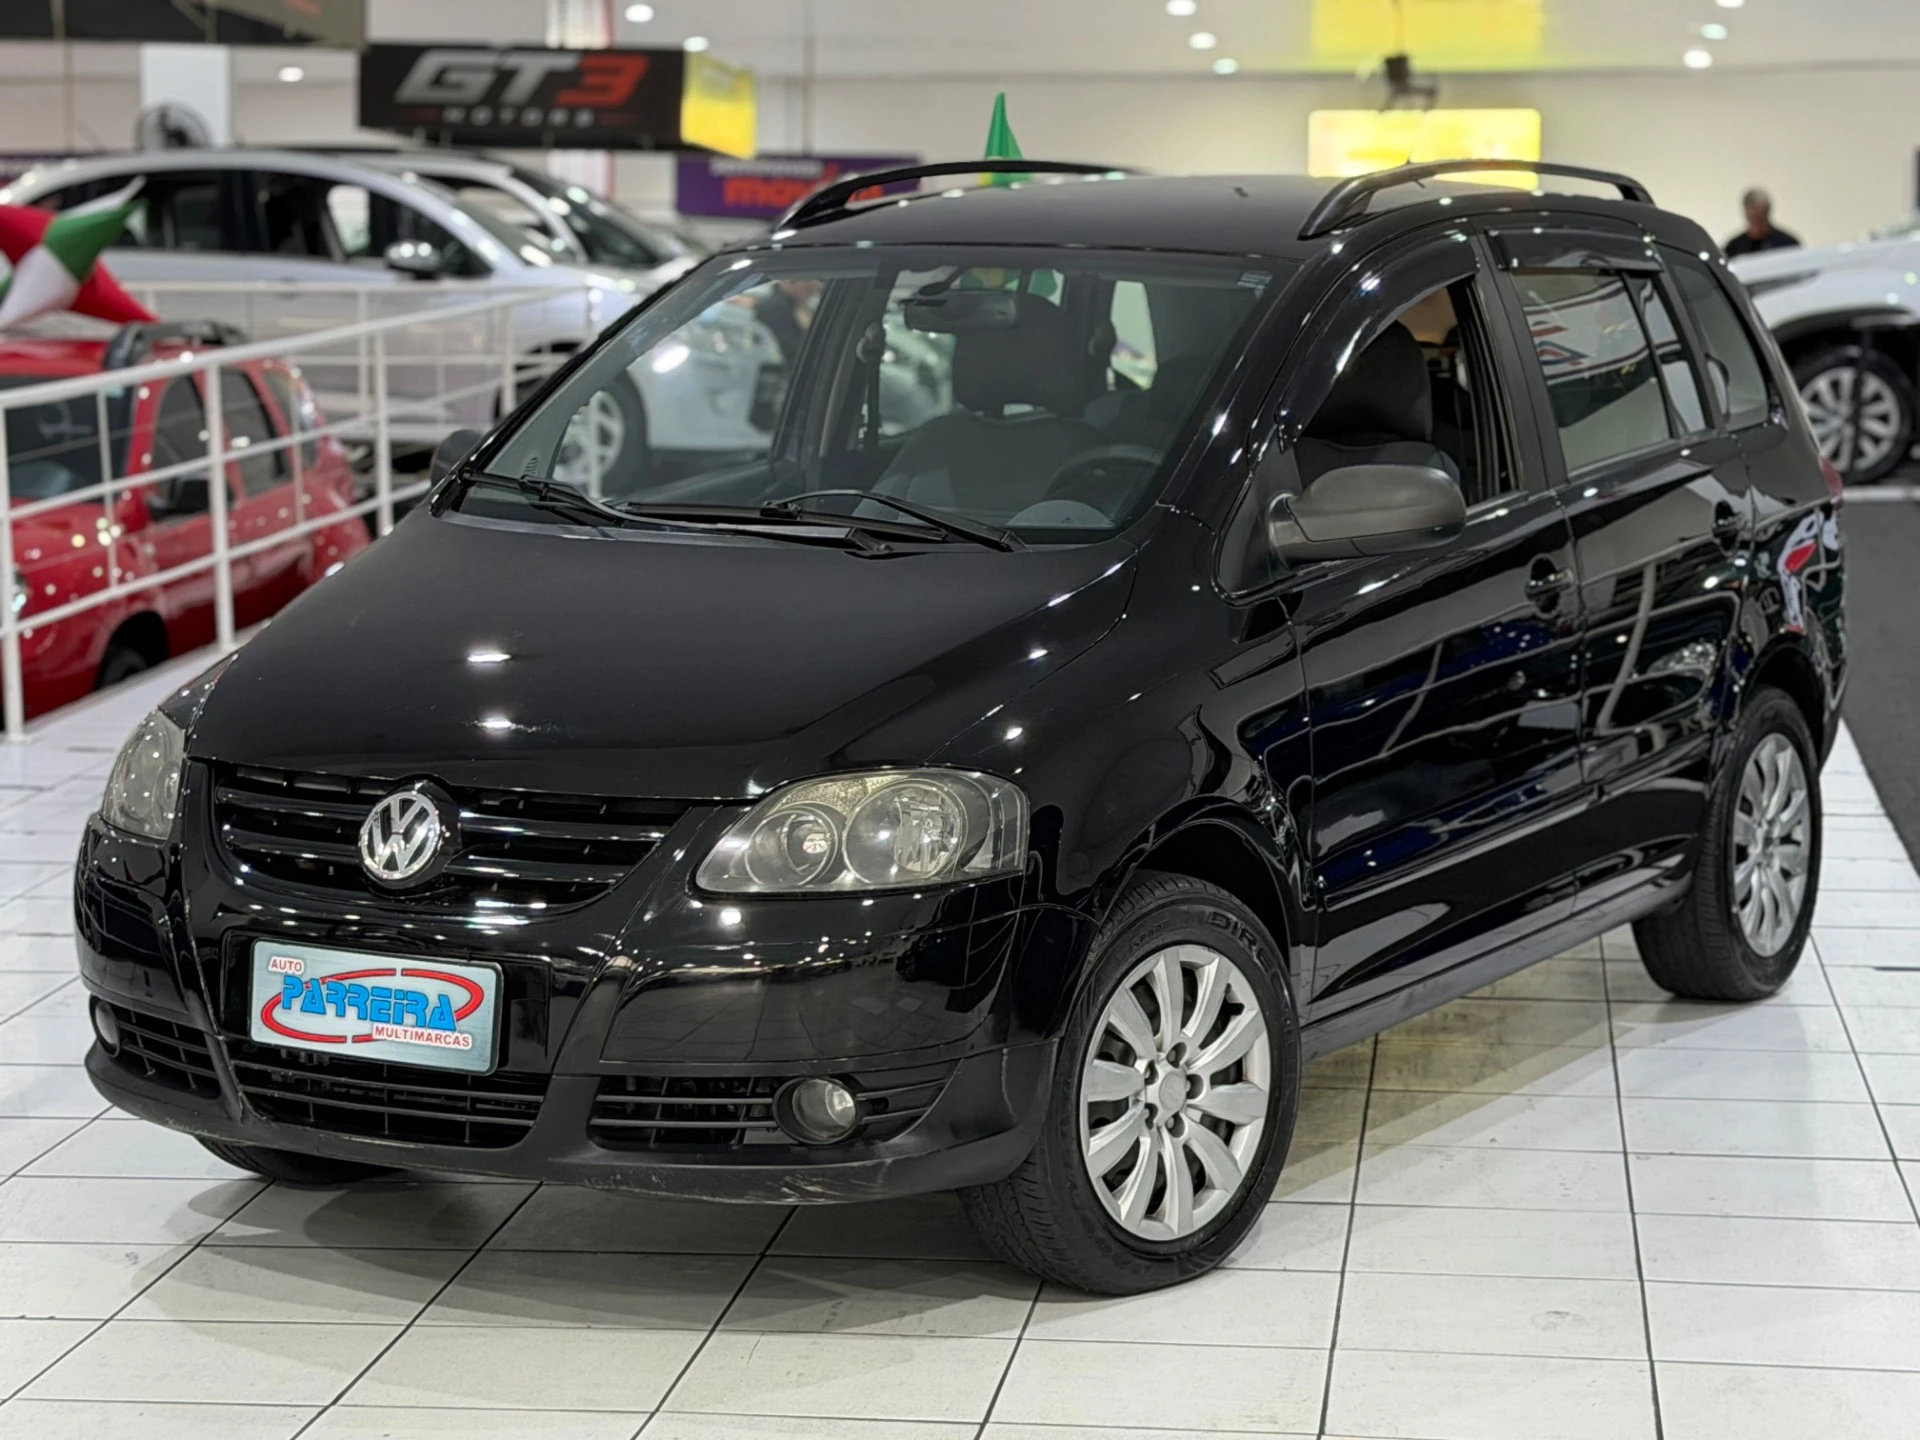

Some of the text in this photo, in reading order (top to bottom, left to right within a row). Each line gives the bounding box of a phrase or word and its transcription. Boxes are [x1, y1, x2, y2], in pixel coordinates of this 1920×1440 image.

[394, 49, 650, 108] GT3
[270, 957, 304, 973] AUTO
[281, 974, 458, 1032] PARREIRA
[374, 1025, 471, 1048] MULTIMARCAS
